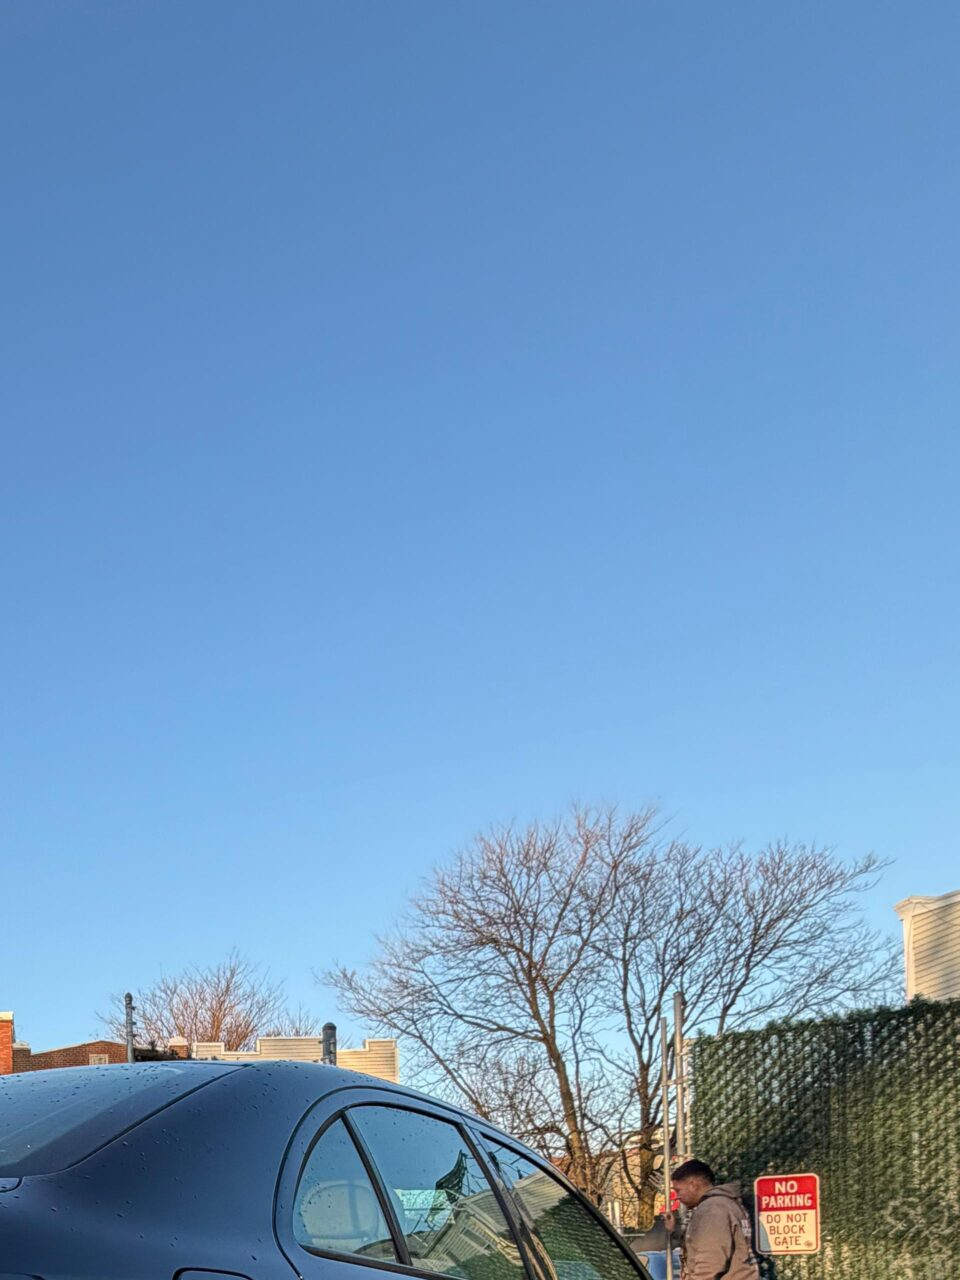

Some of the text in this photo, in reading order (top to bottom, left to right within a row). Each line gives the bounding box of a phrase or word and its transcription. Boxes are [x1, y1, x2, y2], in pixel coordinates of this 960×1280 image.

[775, 1181, 798, 1194] NO
[762, 1194, 812, 1209] PARKING
[767, 1213, 808, 1224] DO NOT
[769, 1225, 806, 1235] BLOCK
[774, 1236, 801, 1246] GATE
